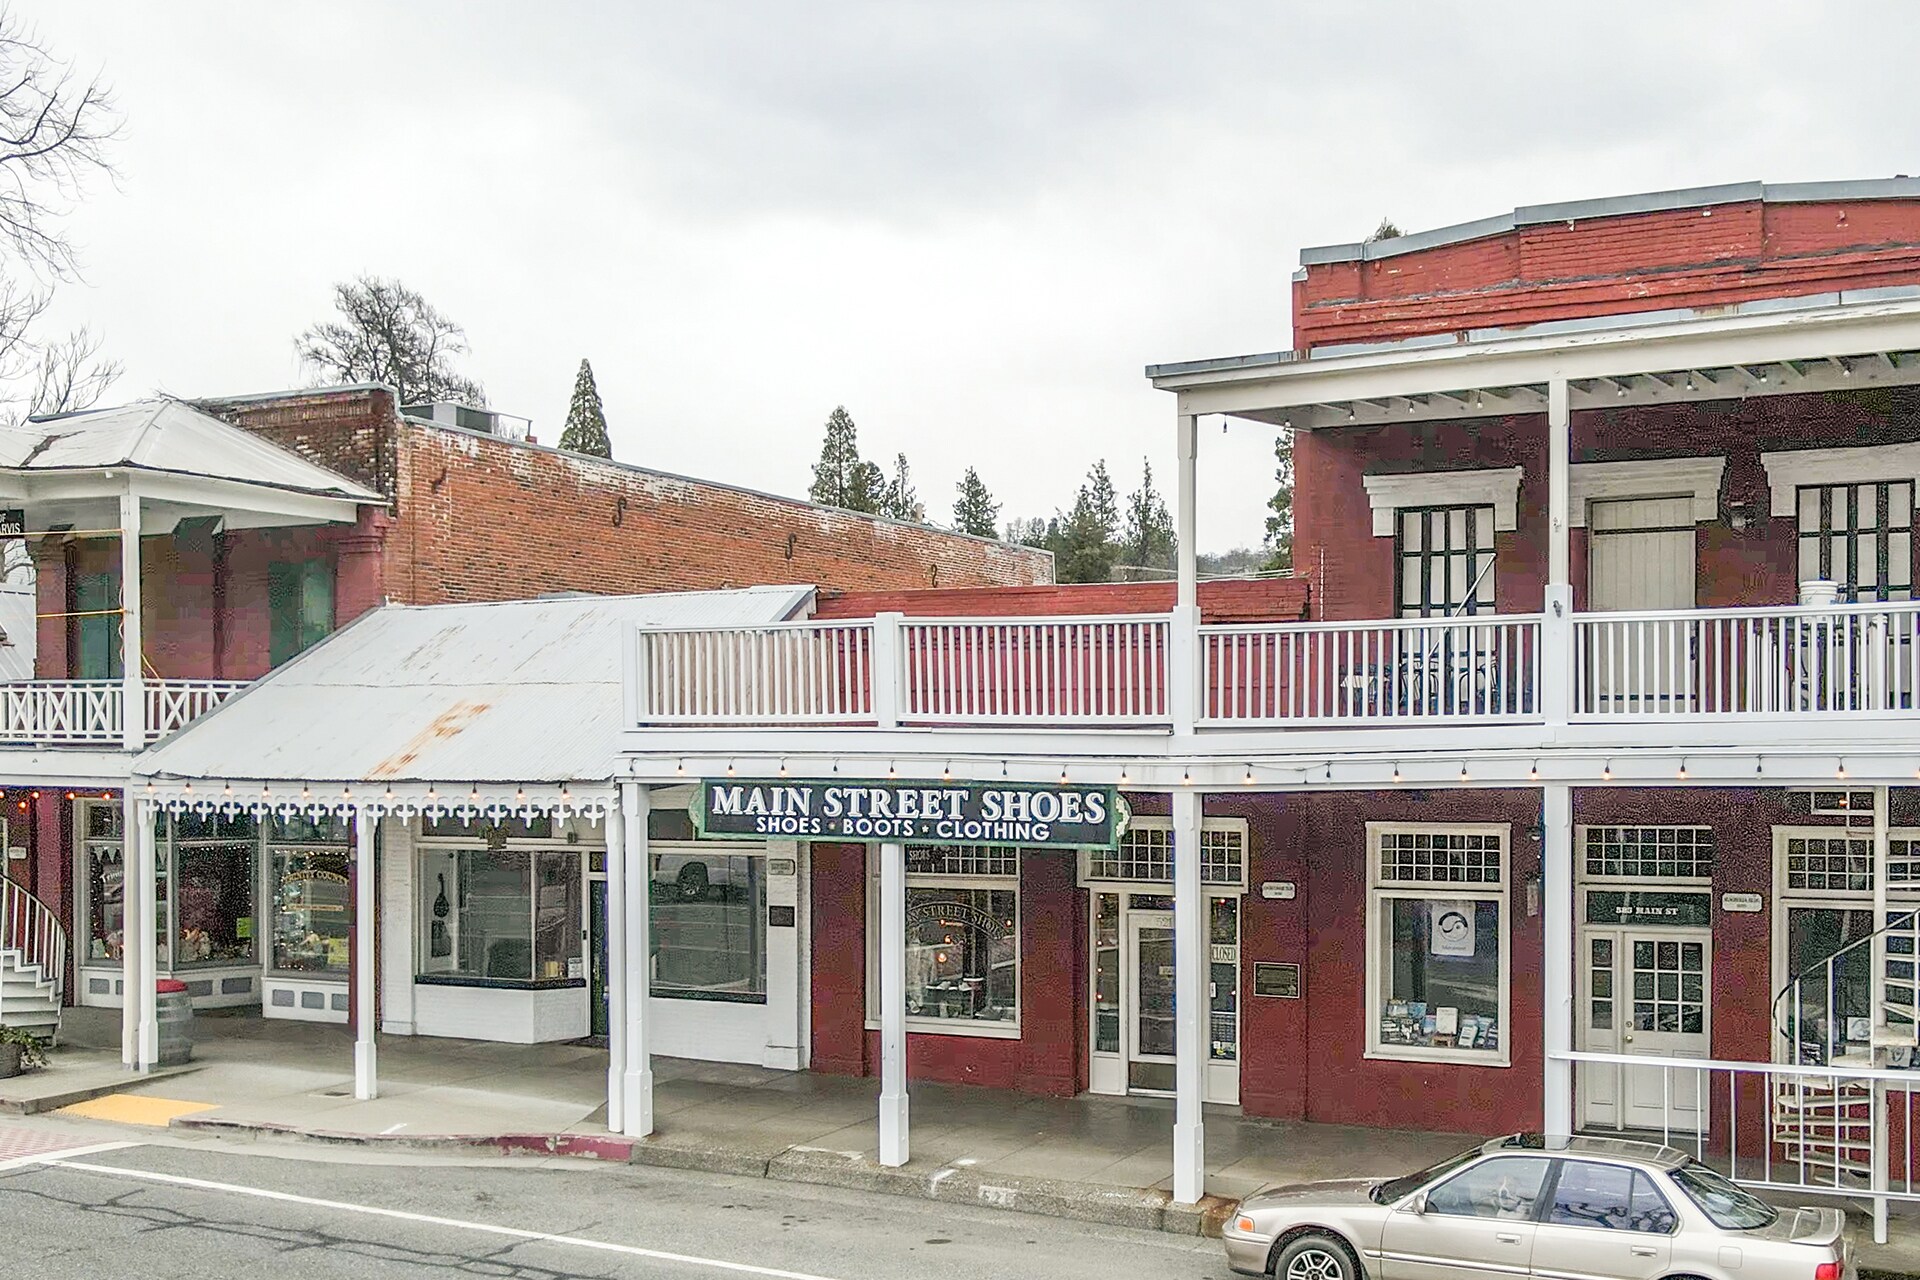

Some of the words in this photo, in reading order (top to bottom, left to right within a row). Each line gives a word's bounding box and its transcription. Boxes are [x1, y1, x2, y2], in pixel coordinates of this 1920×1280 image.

[711, 786, 812, 816] MAIN
[823, 787, 969, 820] STREET
[981, 790, 1106, 824] SHOES
[756, 816, 821, 834] SHOES
[842, 818, 914, 837] BOOTS
[936, 820, 1050, 841] CLOTHING
[922, 904, 969, 920] STREET
[1635, 907, 1663, 915] MAIN
[1665, 907, 1679, 916] ST
